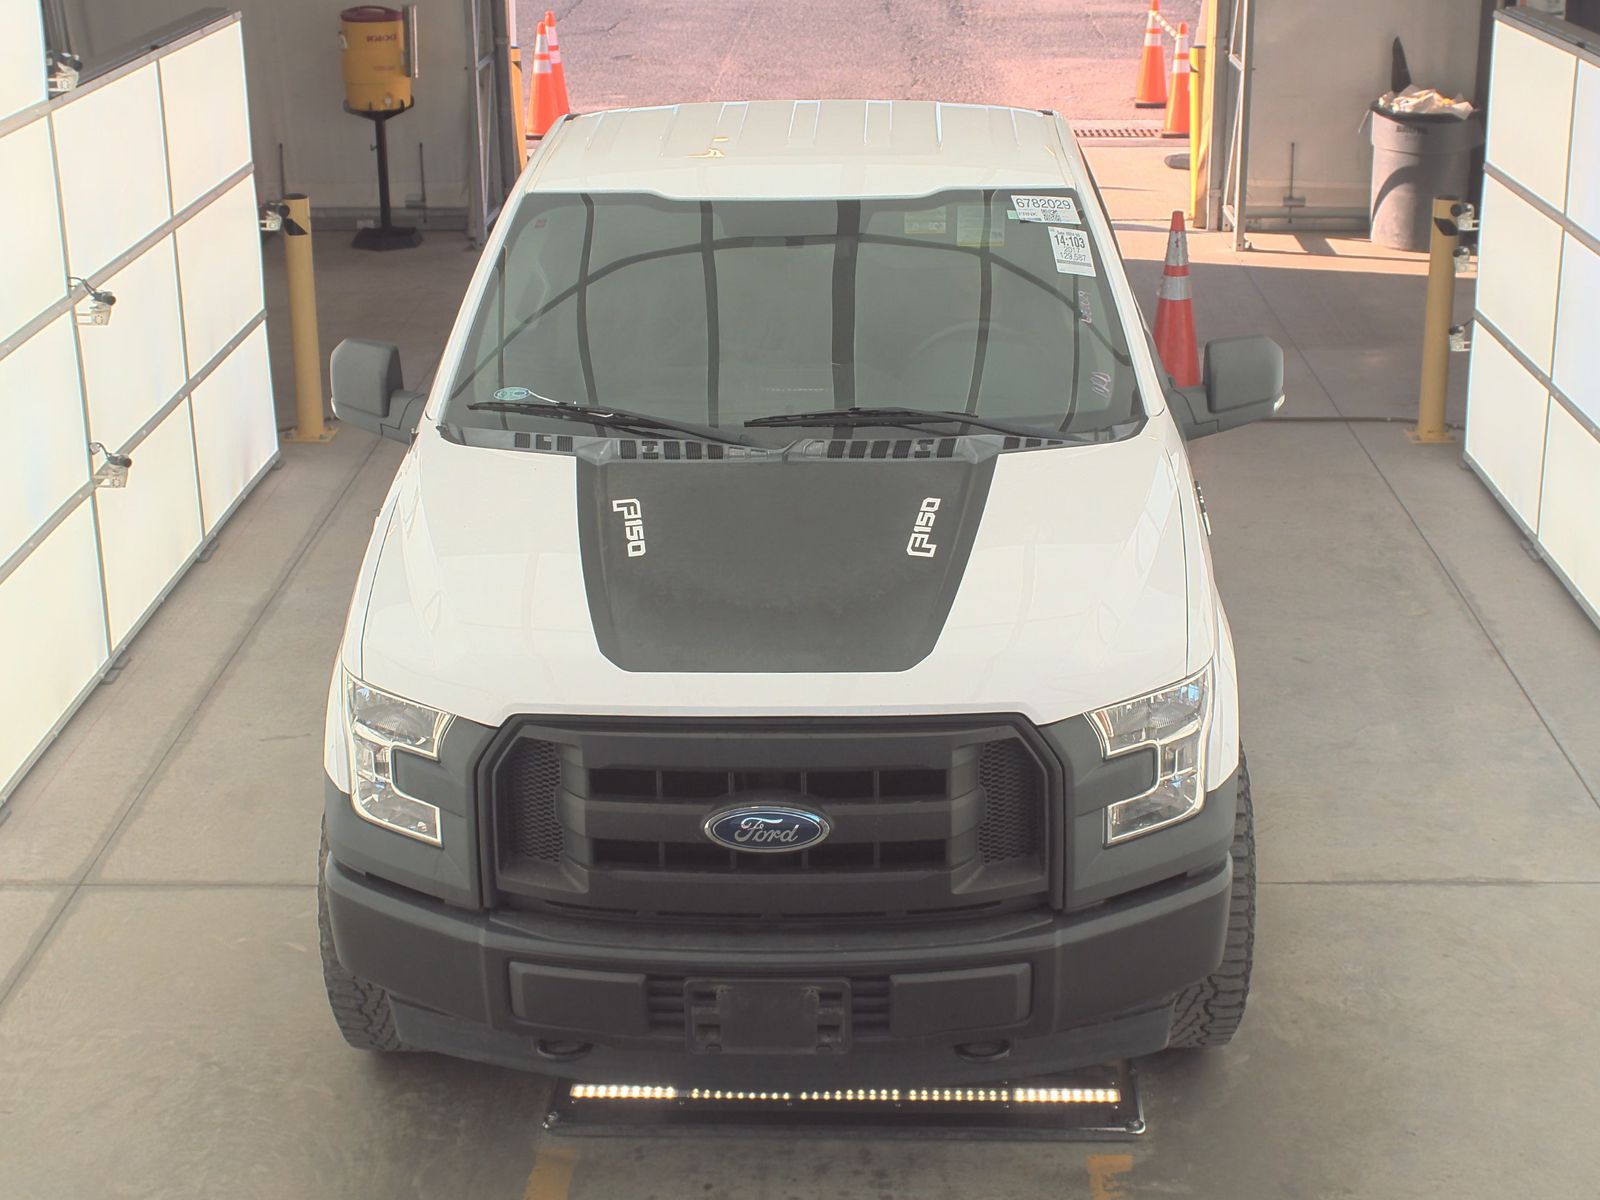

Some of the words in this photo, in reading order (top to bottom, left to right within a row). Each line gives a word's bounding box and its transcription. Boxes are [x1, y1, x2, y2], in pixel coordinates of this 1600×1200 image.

[1016, 198, 1071, 209] 6782029
[1054, 234, 1085, 249] 14:103
[612, 498, 646, 557] F150
[906, 497, 941, 558] F150
[734, 817, 800, 842] Ford
